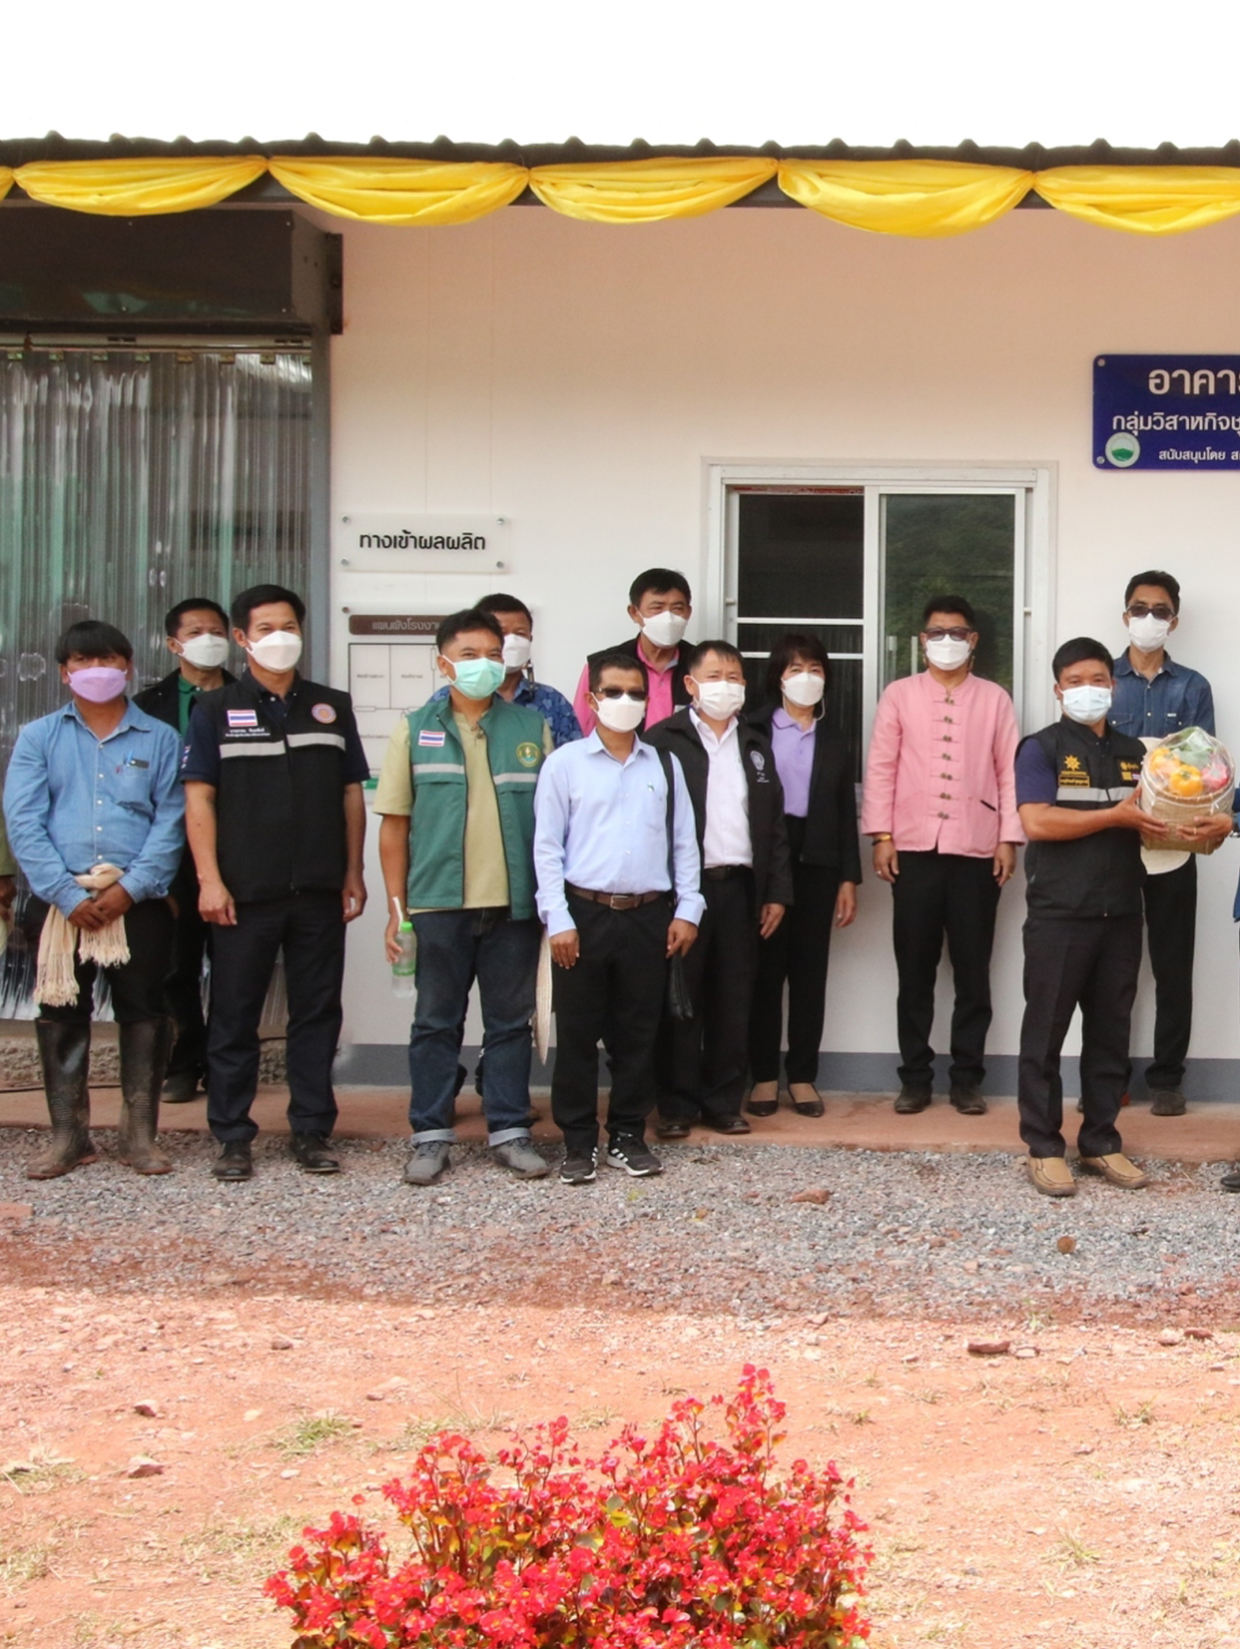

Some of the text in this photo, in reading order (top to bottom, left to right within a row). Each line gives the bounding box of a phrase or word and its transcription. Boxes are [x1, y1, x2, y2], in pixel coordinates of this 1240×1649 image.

[1158, 446, 1226, 464] สนับสนุนโดย
[359, 528, 486, 550] ทางเข้าผลผลิต
